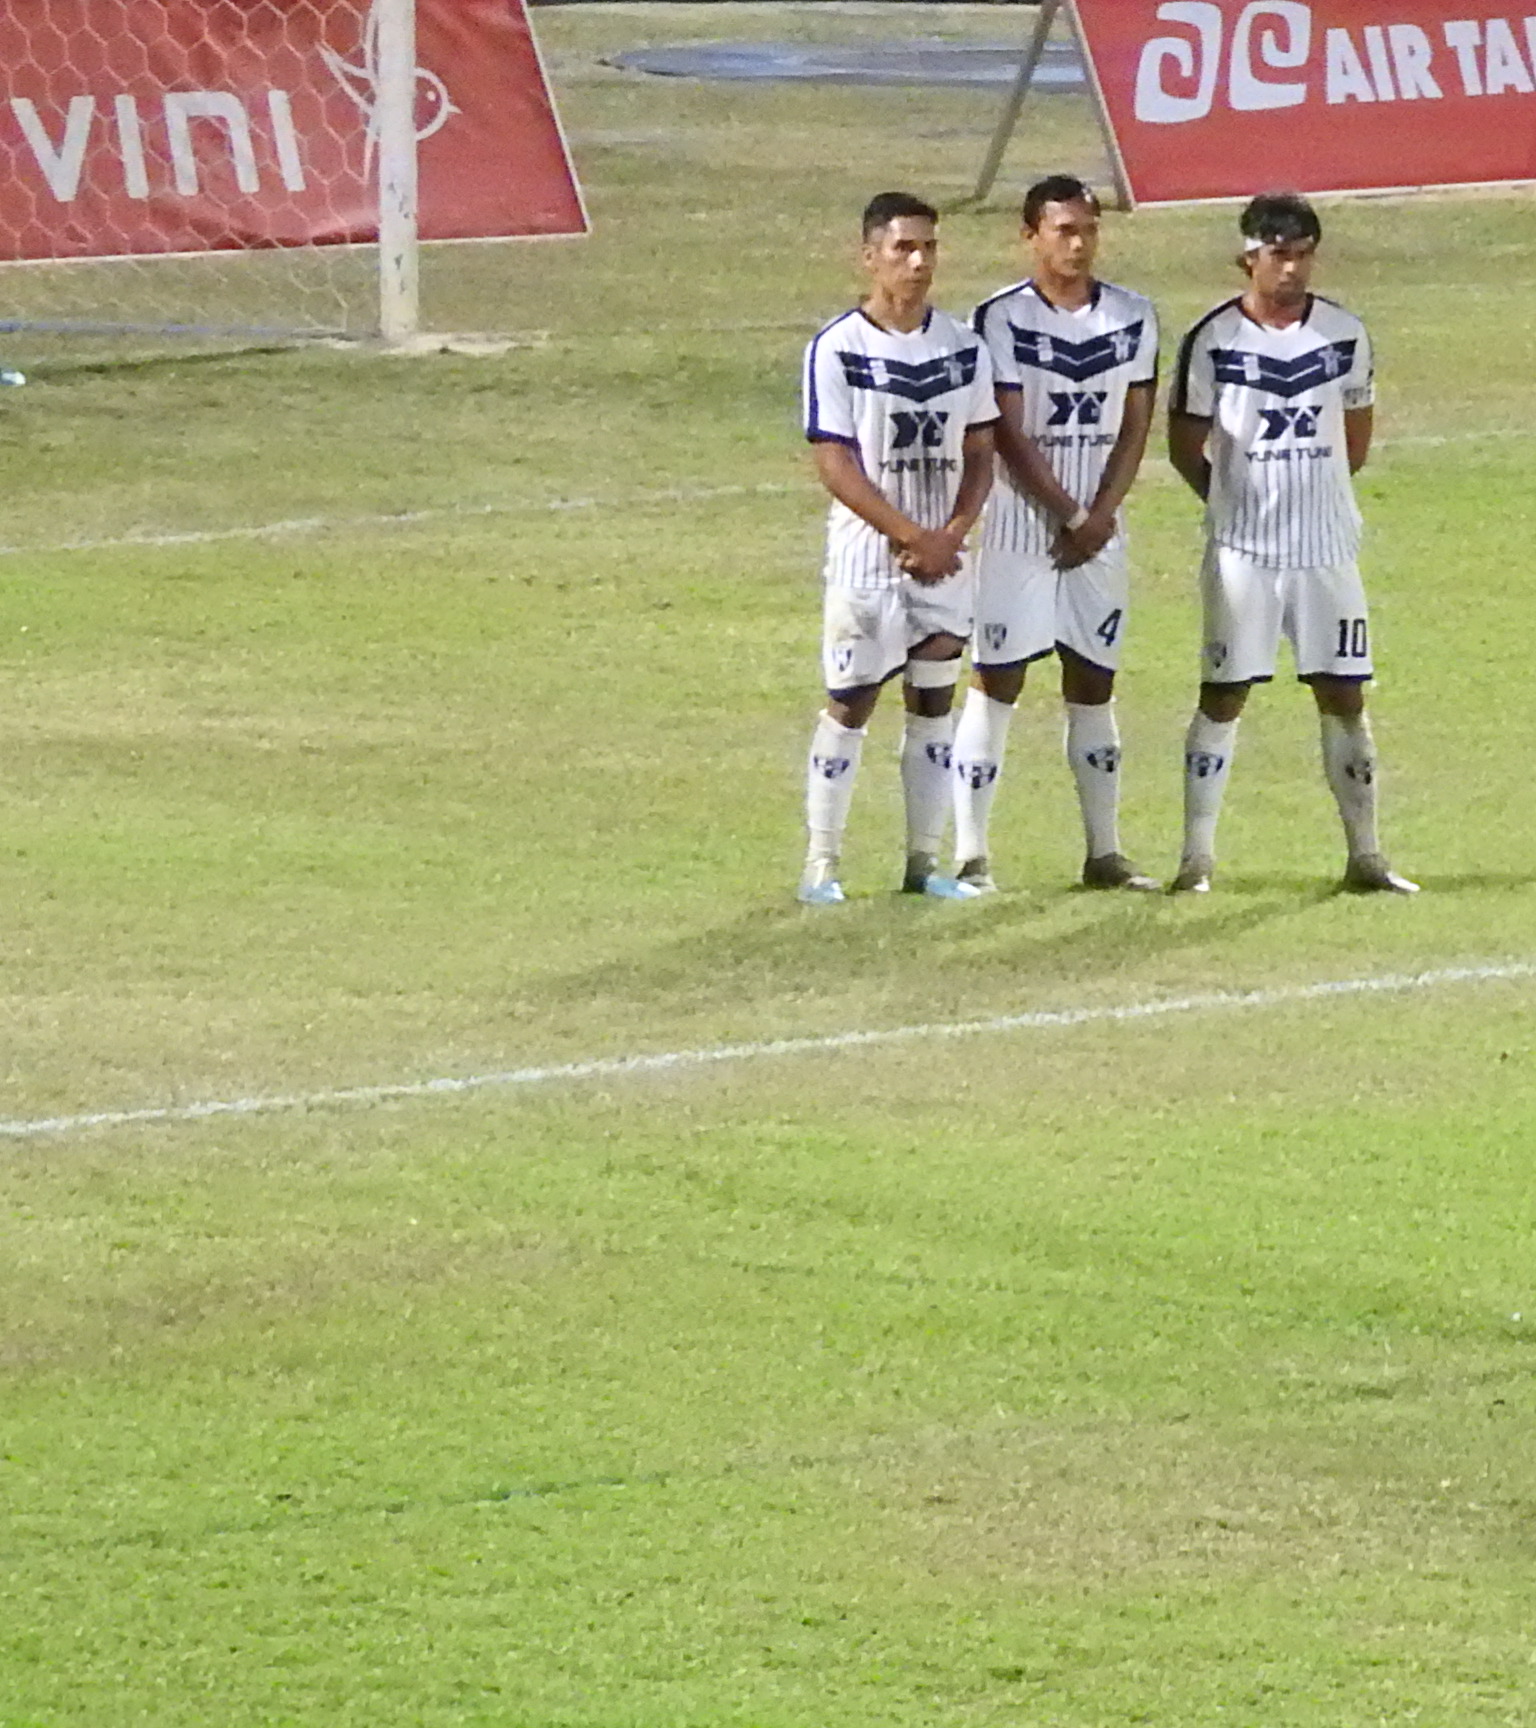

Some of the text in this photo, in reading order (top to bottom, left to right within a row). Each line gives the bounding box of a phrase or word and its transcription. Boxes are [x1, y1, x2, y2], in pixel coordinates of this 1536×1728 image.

[1325, 25, 1442, 105] AIR
[1097, 608, 1122, 647] 4
[1334, 618, 1367, 658] 10
